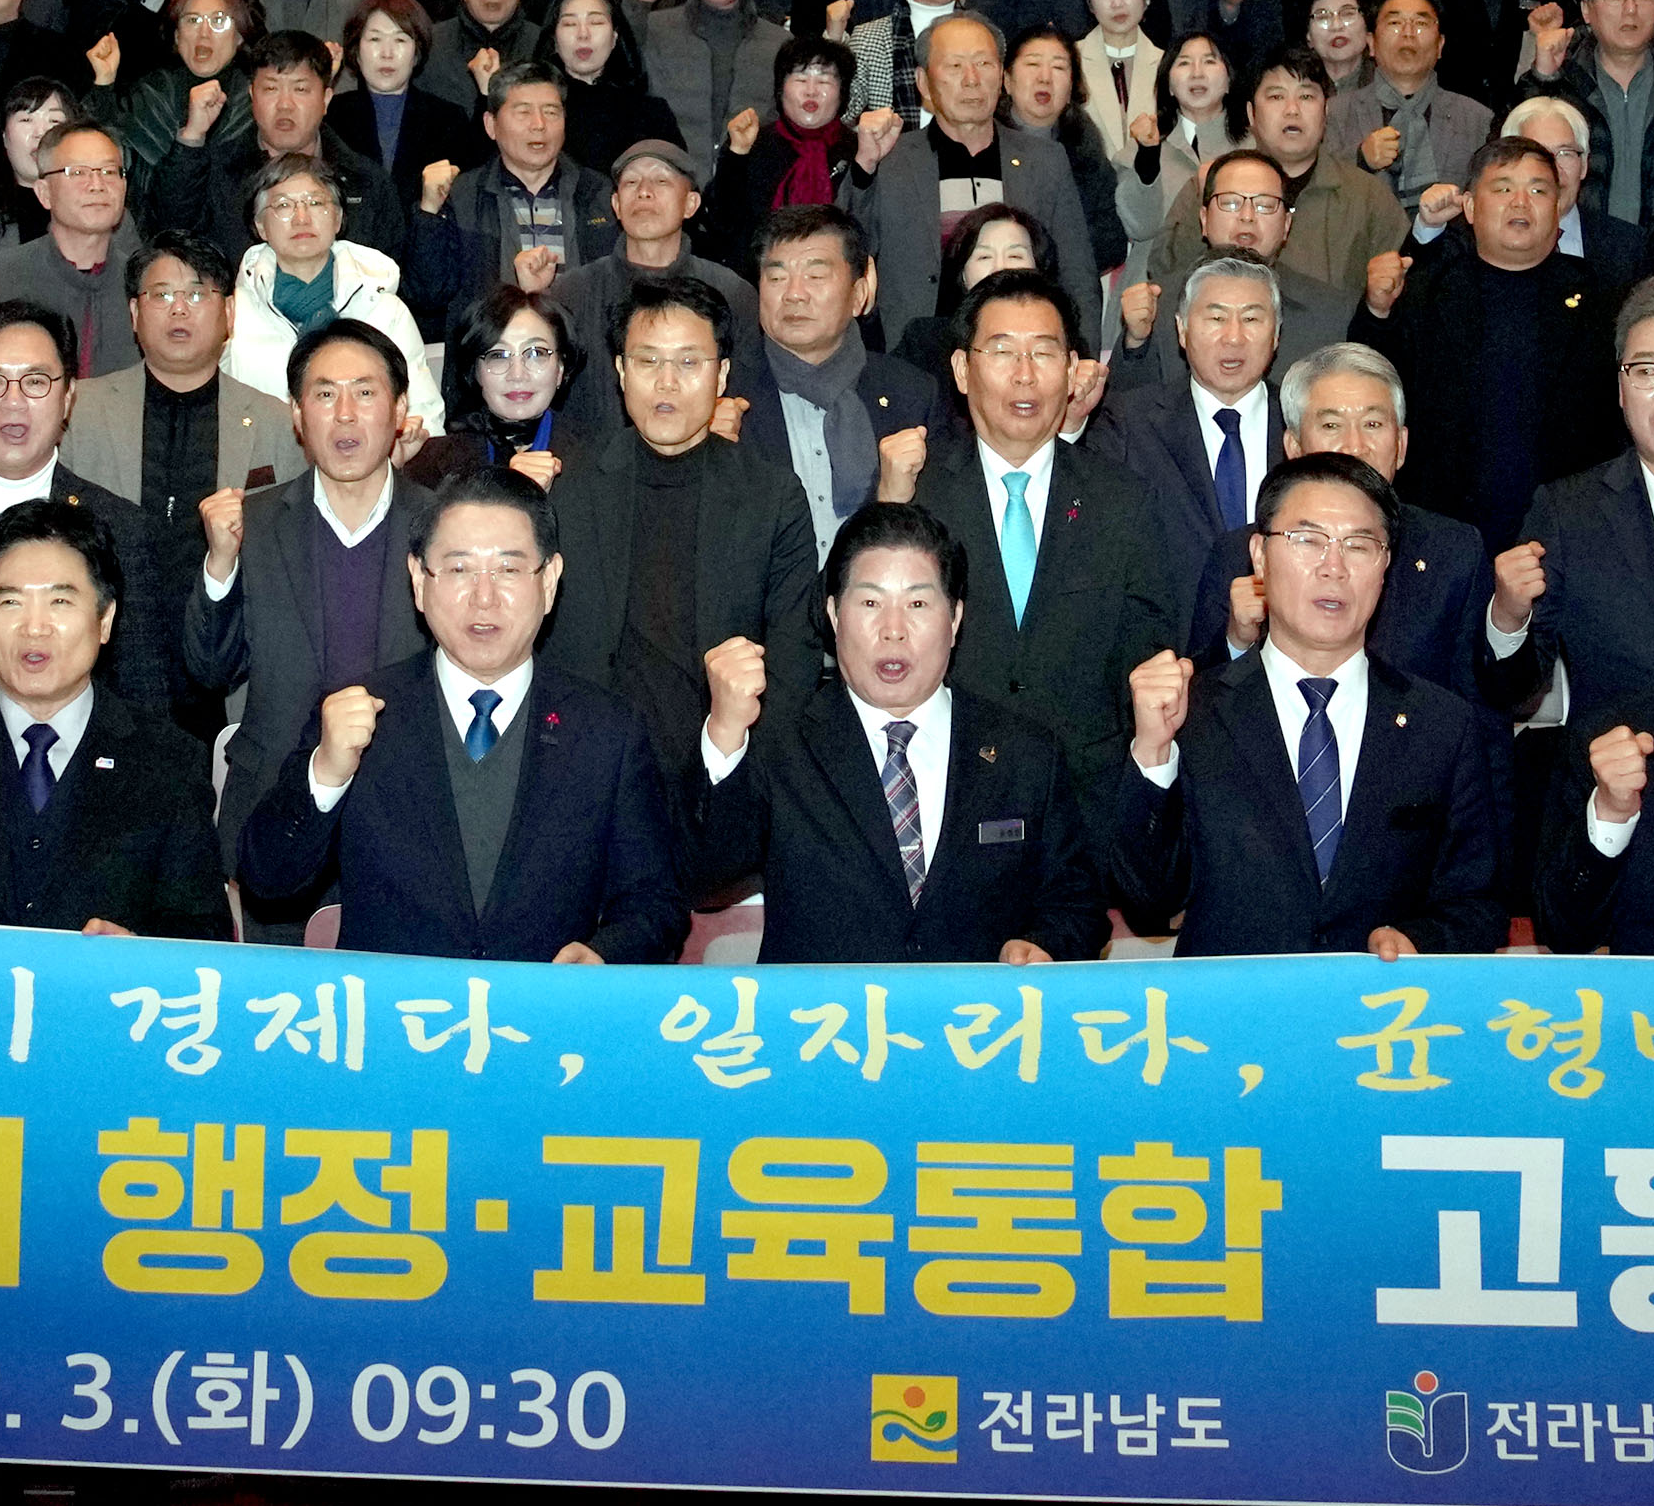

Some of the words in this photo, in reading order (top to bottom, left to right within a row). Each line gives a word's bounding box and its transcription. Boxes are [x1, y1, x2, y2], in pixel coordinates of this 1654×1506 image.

[109, 966, 586, 1087] 경제다,
[659, 982, 1264, 1097] 일자리다,
[60, 1350, 314, 1450] 3.(화)
[351, 1363, 627, 1451] 09:30
[978, 1390, 1231, 1456] 전라남도
